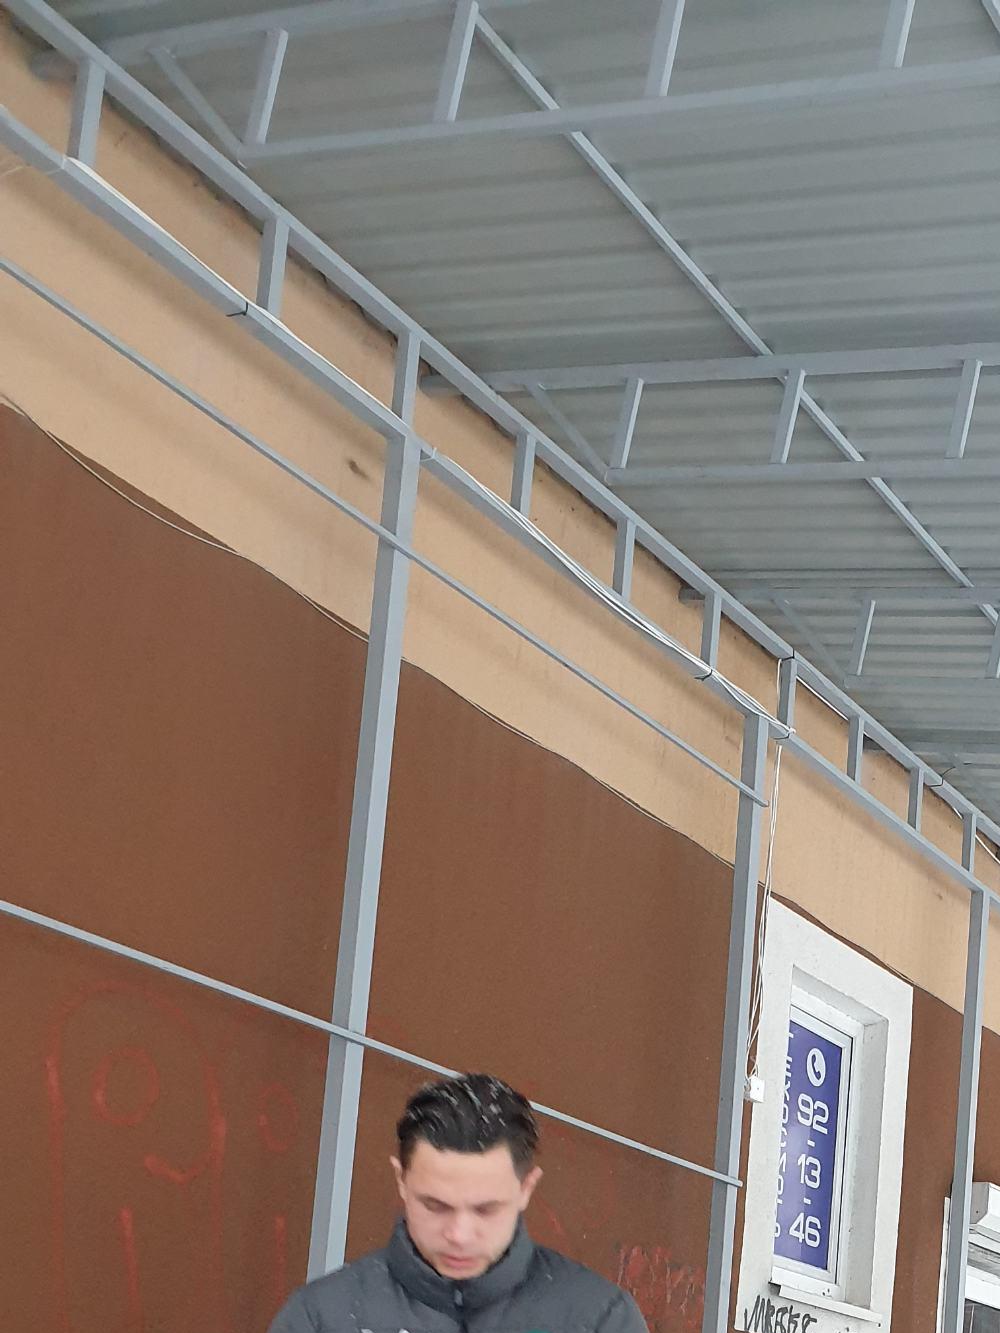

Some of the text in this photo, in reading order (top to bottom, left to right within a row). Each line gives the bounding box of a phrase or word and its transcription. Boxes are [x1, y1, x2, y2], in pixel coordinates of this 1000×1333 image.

[796, 1093, 830, 1135] 92
[797, 1153, 821, 1189] 13
[789, 1212, 821, 1248] 46
